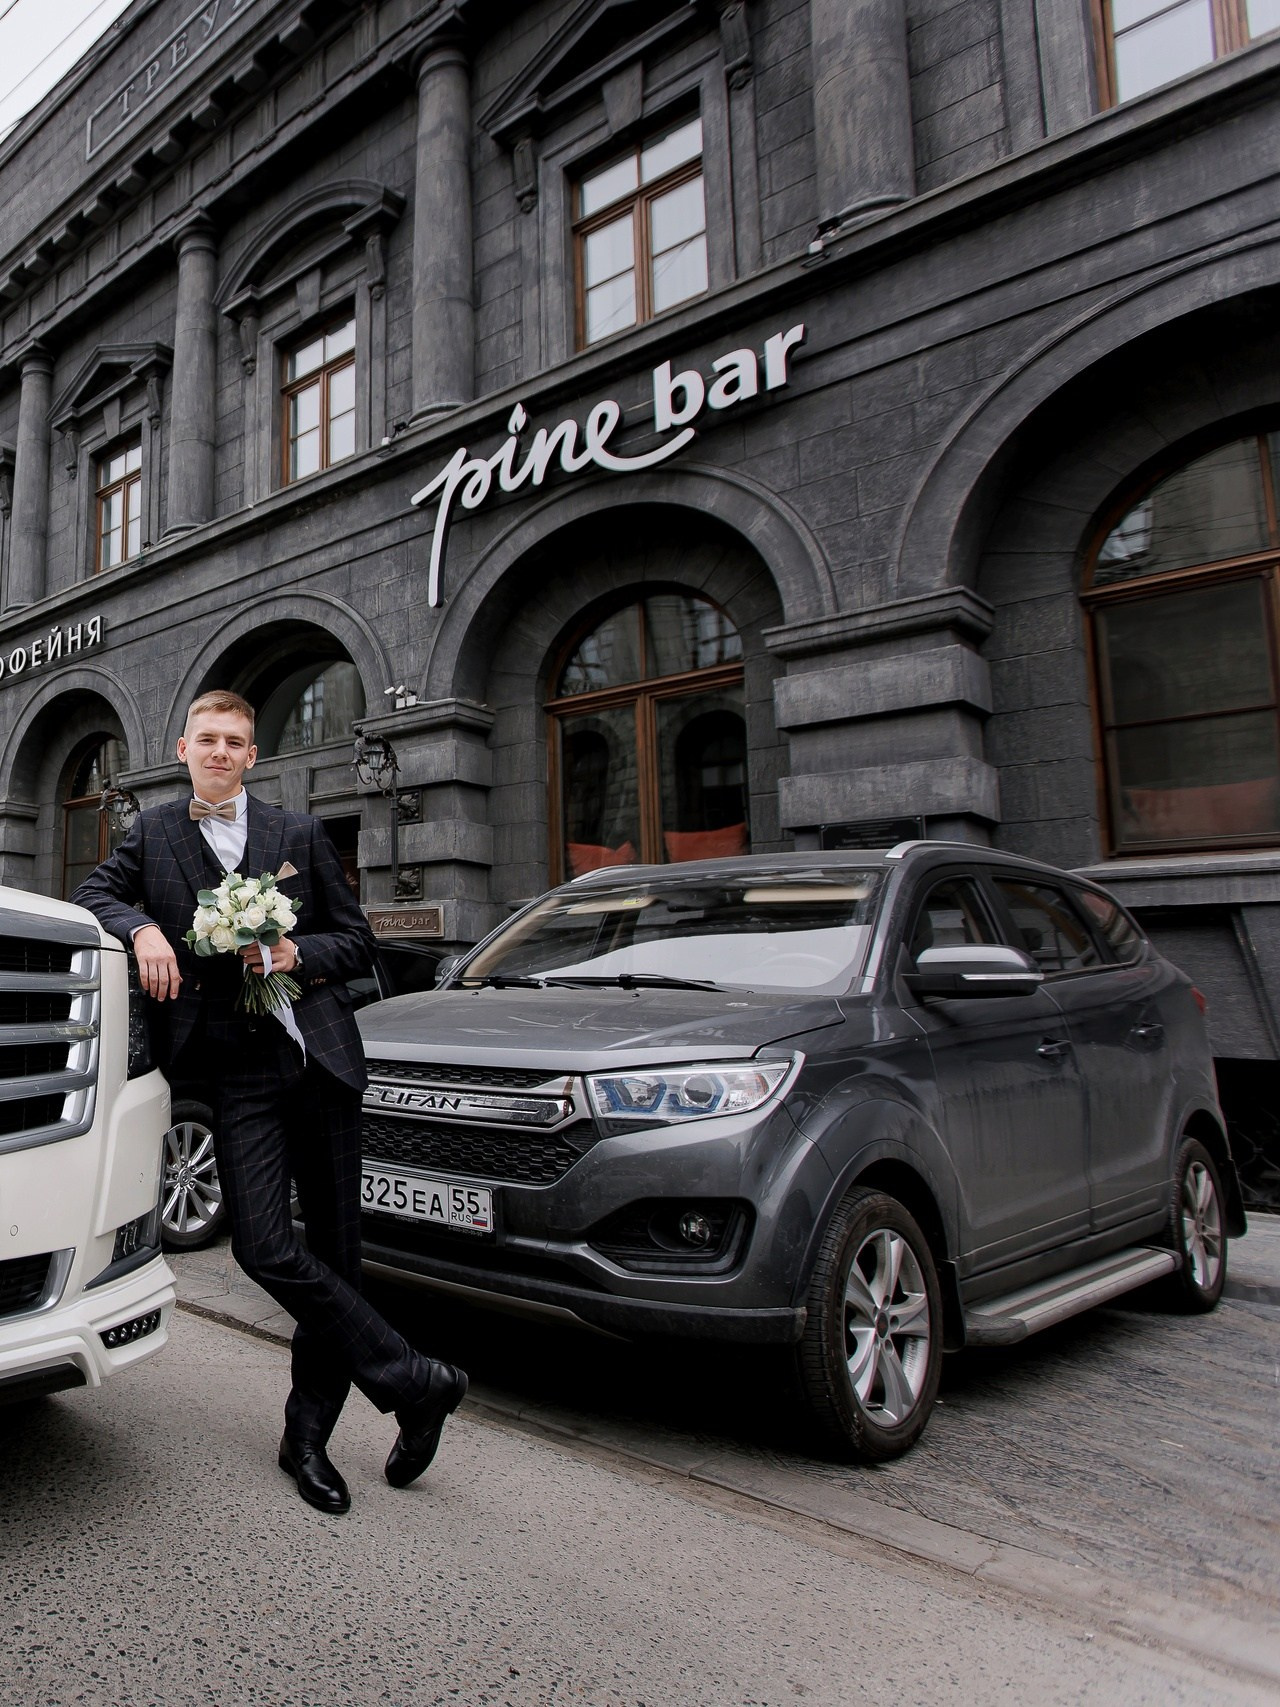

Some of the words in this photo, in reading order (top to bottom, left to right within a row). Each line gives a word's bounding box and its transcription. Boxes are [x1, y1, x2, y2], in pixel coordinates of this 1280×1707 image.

[119, 0, 240, 116] ТРЕУ
[410, 400, 696, 607] pine
[654, 324, 805, 433] bar
[375, 914, 412, 936] pine
[412, 916, 430, 926] bar
[380, 1090, 462, 1111] LIFAN
[362, 1174, 444, 1218] 325ЕА
[452, 1188, 480, 1215] 55
[451, 1211, 472, 1224] RUS
